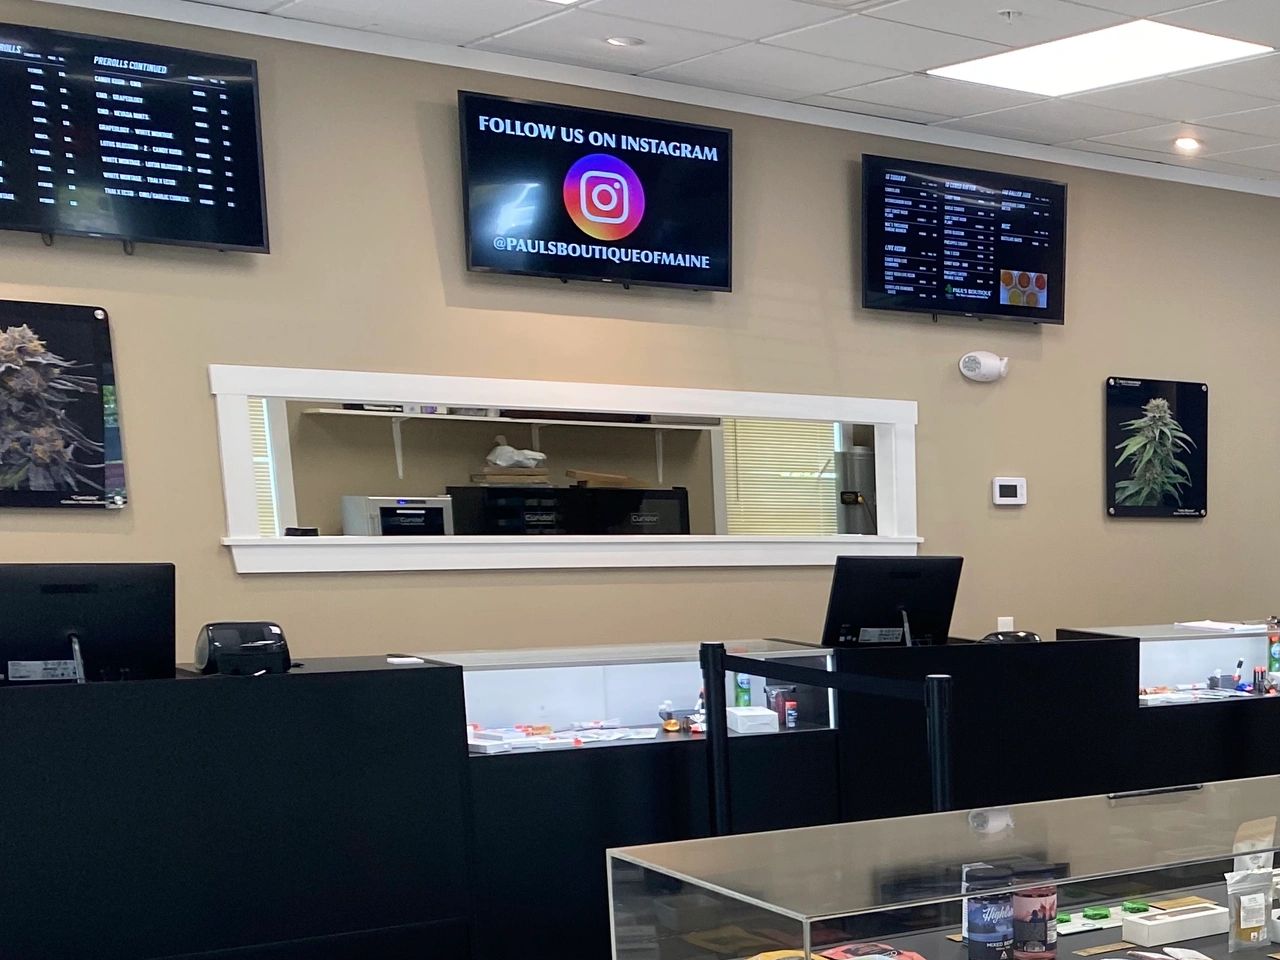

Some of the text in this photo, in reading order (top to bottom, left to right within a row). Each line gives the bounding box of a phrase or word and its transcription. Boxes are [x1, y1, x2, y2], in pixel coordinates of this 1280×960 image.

[93, 55, 168, 74] PREROLLS CONTINUED
[478, 115, 719, 162] FOLLOW US ON INSTAGRAM
[493, 236, 711, 269] @PAULSBOUTIQUEOFMAINE
